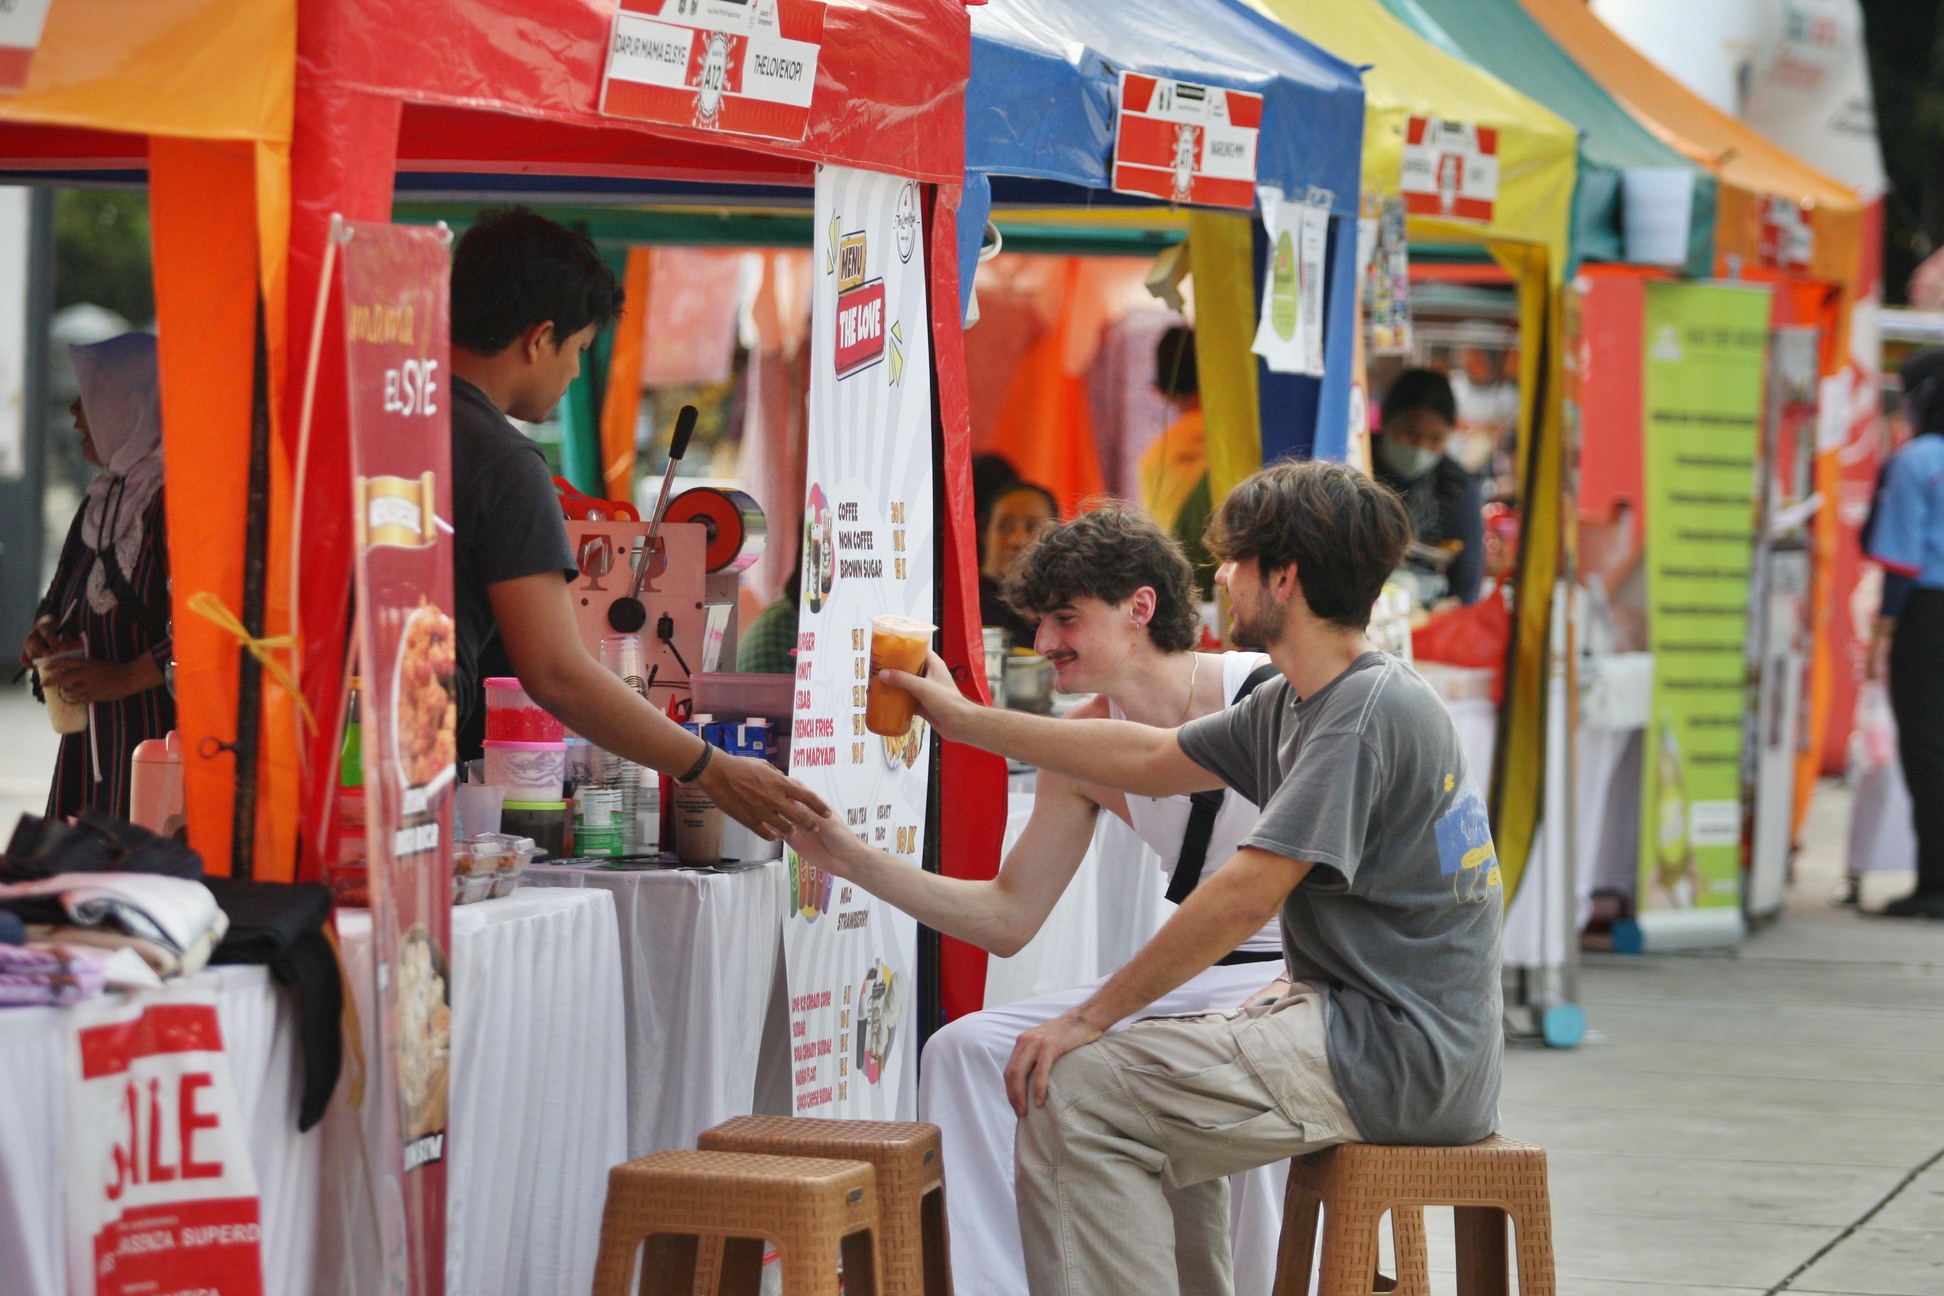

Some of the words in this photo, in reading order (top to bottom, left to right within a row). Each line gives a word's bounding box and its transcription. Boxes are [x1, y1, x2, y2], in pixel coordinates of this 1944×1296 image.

[641, 39, 665, 63] MAMA
[664, 42, 687, 66] ELSYE
[703, 64, 722, 90] A12
[841, 244, 863, 281] MENU
[839, 304, 857, 349] THE
[857, 297, 881, 342] LOVE
[838, 502, 858, 521] COFFEE
[839, 531, 853, 550] NON
[853, 531, 873, 550] COFFEE
[840, 559, 862, 579] BROWN
[863, 559, 883, 578] SUGAR
[794, 718, 814, 739] FRENCH
[837, 910, 869, 931] STRAWBERRY
